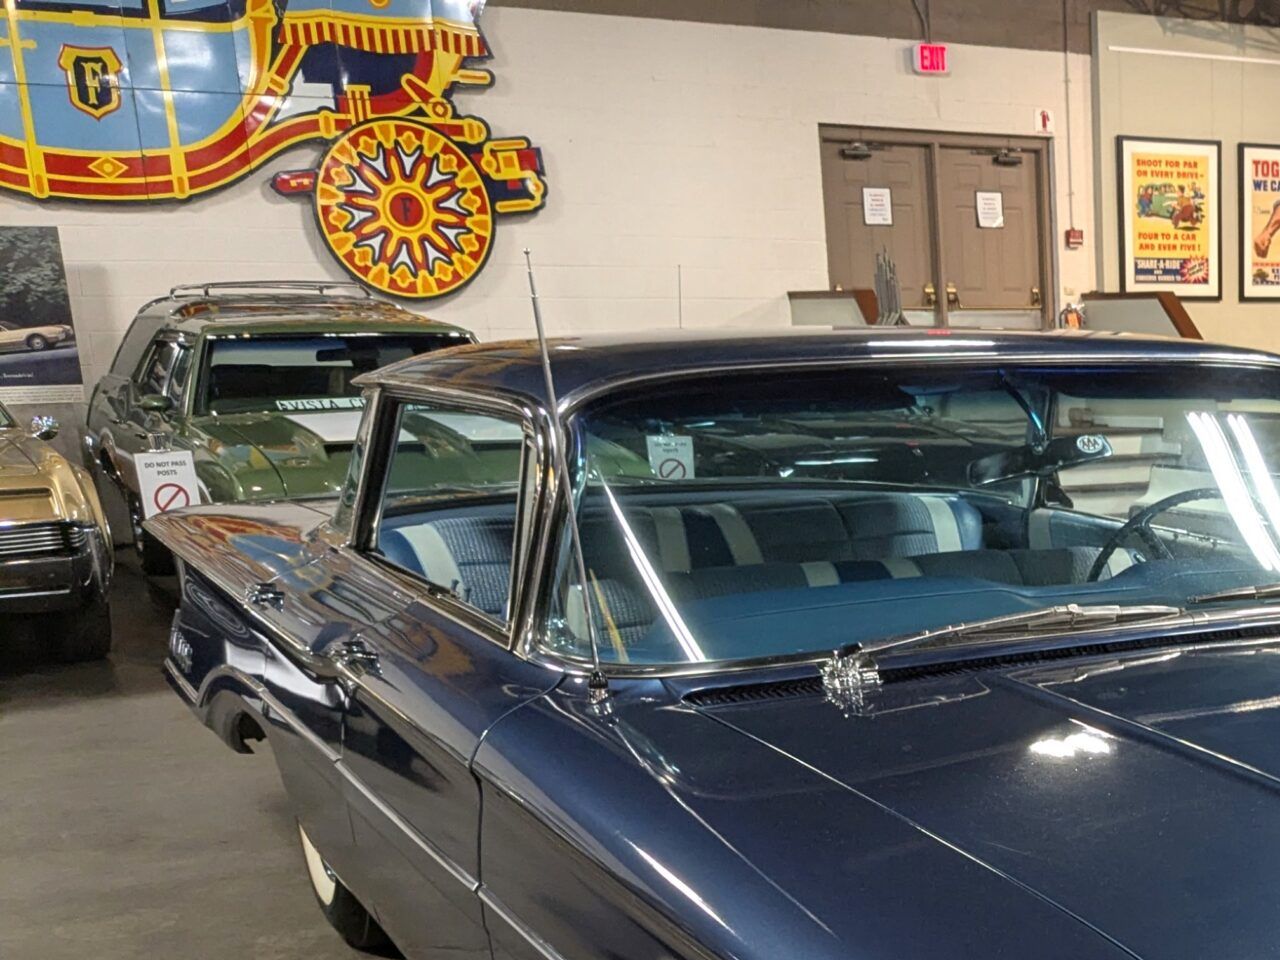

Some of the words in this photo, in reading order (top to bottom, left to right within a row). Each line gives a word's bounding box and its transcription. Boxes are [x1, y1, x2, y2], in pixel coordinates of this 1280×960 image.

[920, 45, 946, 71] EXIT
[81, 62, 103, 105] F
[1136, 159, 1162, 168] SHOOT
[1165, 160, 1180, 168] FOR
[1183, 160, 1198, 169] PAR
[1136, 169, 1148, 177] ON
[1150, 170, 1174, 178] EVERY
[1253, 180, 1268, 192] WE
[400, 197, 412, 222] F
[1138, 232, 1158, 241] FOUR
[1161, 233, 1170, 241] TO
[1173, 233, 1179, 241] A
[1181, 233, 1196, 241] CAR
[1139, 243, 1156, 251] AND
[1158, 243, 1177, 251] EVEN
